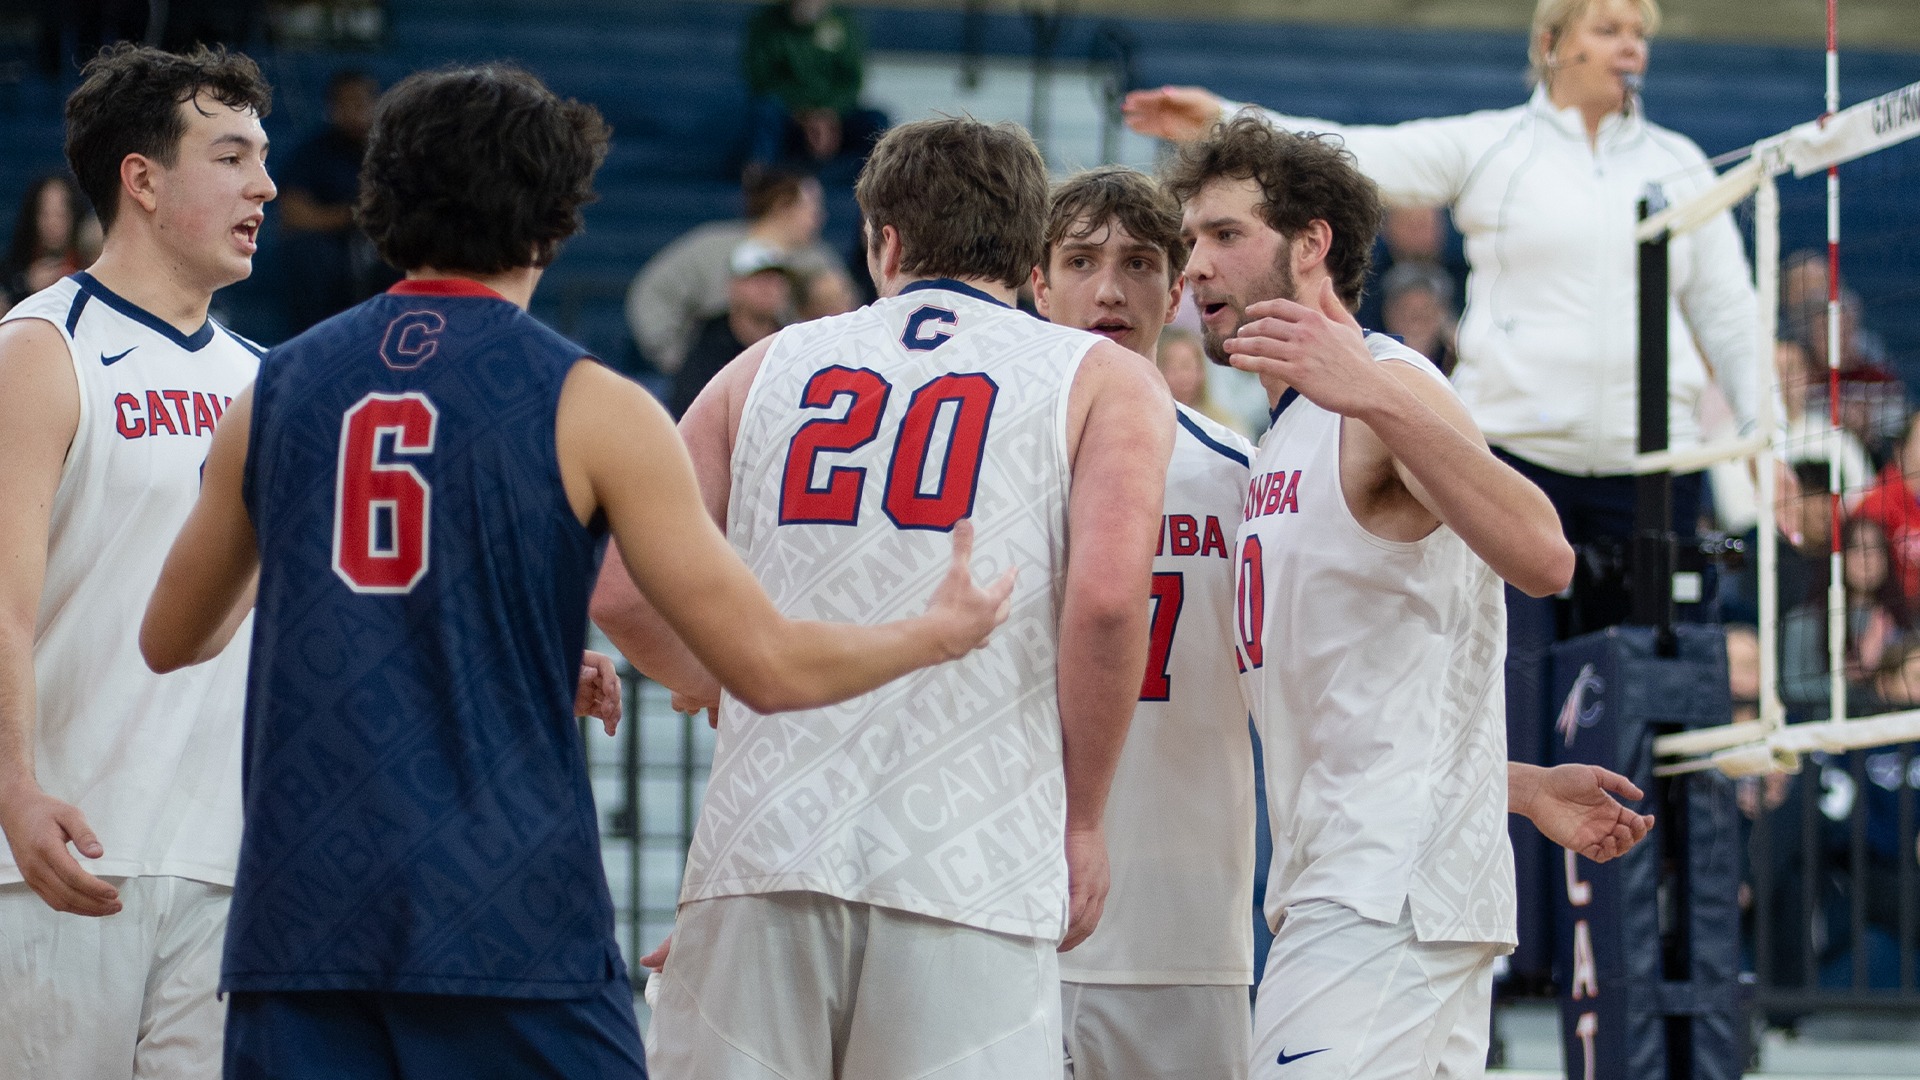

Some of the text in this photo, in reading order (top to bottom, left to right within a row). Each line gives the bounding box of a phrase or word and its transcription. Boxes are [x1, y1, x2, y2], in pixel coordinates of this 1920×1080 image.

[380, 310, 446, 369] C
[899, 304, 959, 352] C
[778, 364, 999, 533] 20
[331, 392, 440, 595] 6
[1155, 514, 1228, 559] BA
